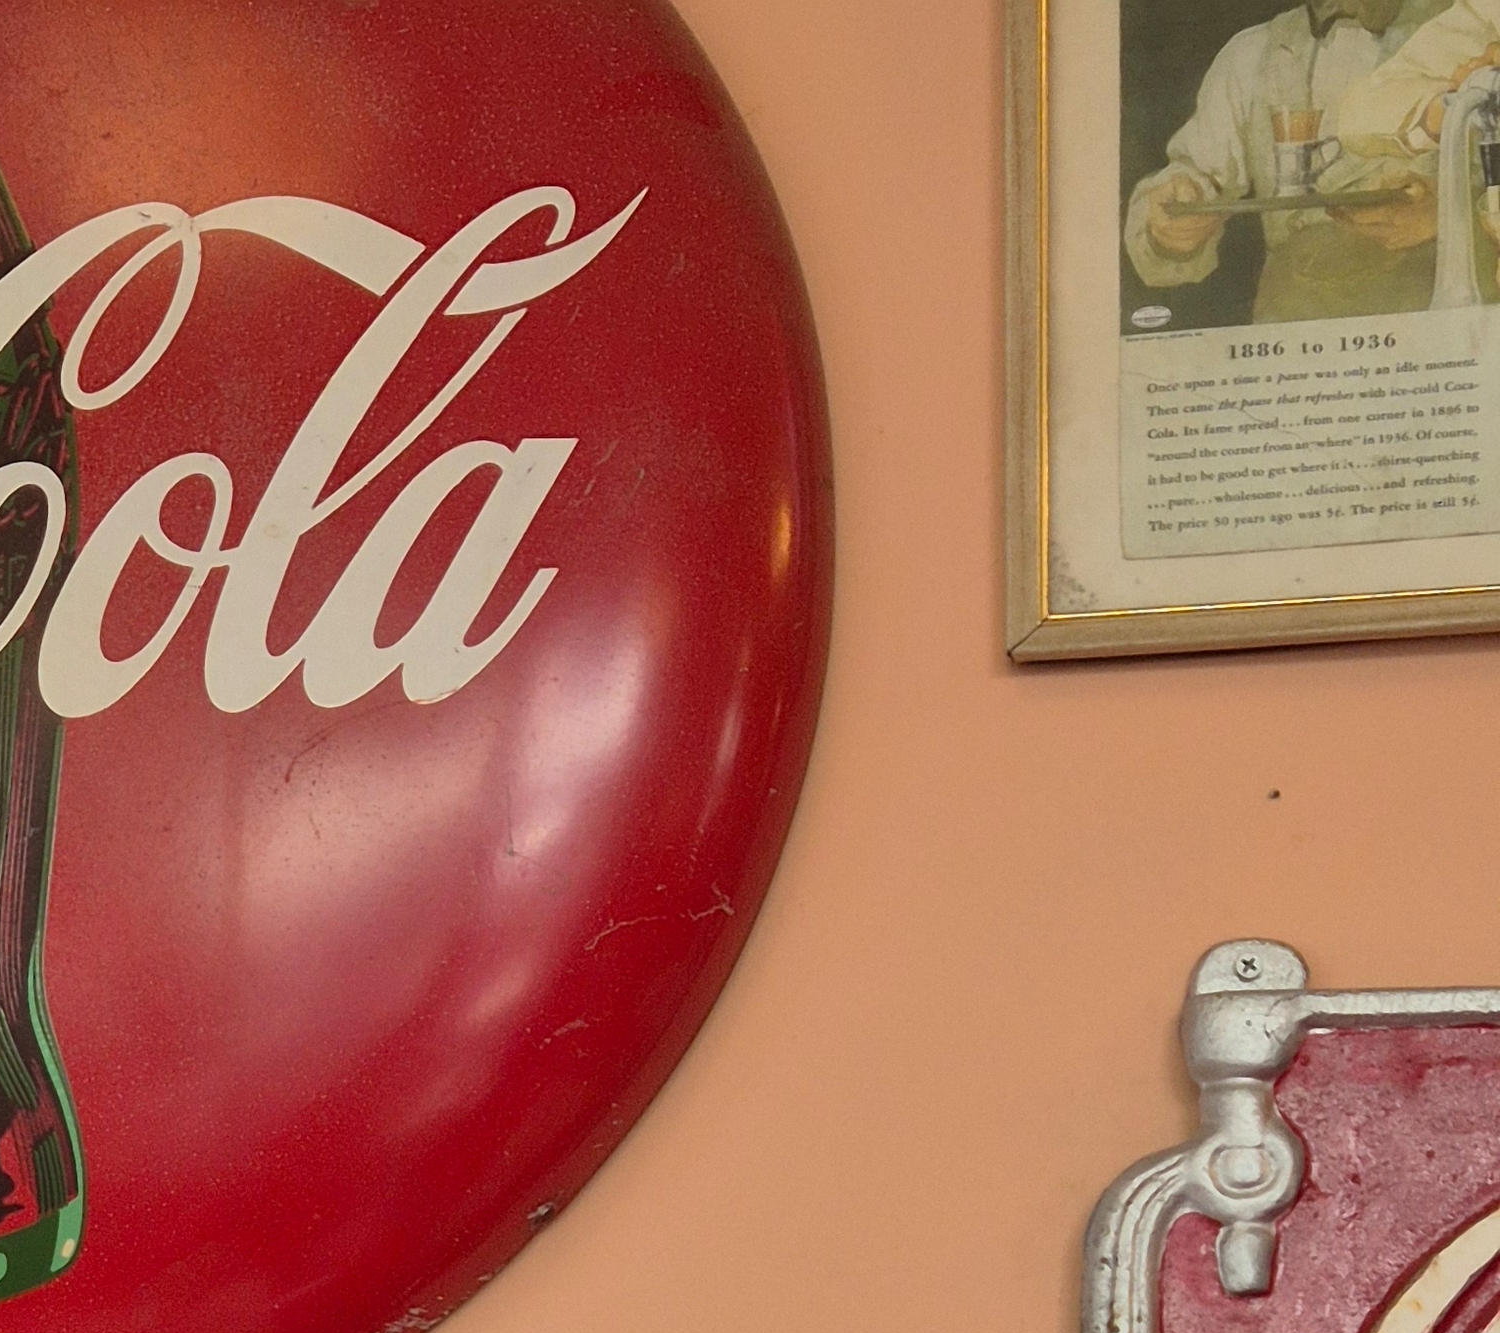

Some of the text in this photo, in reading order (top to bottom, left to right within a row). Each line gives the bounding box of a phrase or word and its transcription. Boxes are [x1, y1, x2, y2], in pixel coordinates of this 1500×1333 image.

[1227, 332, 1396, 360] 1886 to 1936
[1147, 382, 1181, 395] Once
[1184, 379, 1215, 393] upon
[1233, 375, 1260, 385] time
[1277, 372, 1309, 386] pause
[1315, 370, 1338, 379] was
[1343, 365, 1370, 379] only
[1396, 360, 1420, 373] idle
[1146, 405, 1179, 418] Then
[1183, 400, 1215, 414] came
[1218, 398, 1237, 410] the
[1239, 397, 1272, 413] pause
[1276, 393, 1301, 406] that
[1305, 390, 1354, 406] refreshes
[1358, 387, 1386, 399] with
[1390, 382, 1439, 397] ice-cold
[1183, 425, 1199, 437] Its
[1204, 423, 1233, 435] fame
[1338, 415, 1361, 424] one
[1366, 411, 1406, 422] corner
[1431, 403, 1462, 417] 1886
[1199, 447, 1218, 458] the
[1220, 445, 1260, 457] corner
[1263, 442, 1293, 454] from
[1379, 430, 1412, 444] 1936.
[1159, 472, 1182, 485] had
[1217, 466, 1249, 483] good
[1268, 466, 1287, 479] get
[1290, 462, 1328, 473] where
[1413, 472, 1479, 488] refreshing.
[1148, 519, 1173, 533] The
[1178, 517, 1209, 533] price
[1234, 515, 1265, 529] years
[1270, 513, 1292, 526] ago
[1298, 510, 1321, 520] was
[1350, 503, 1375, 516] The
[1379, 500, 1411, 516] price
